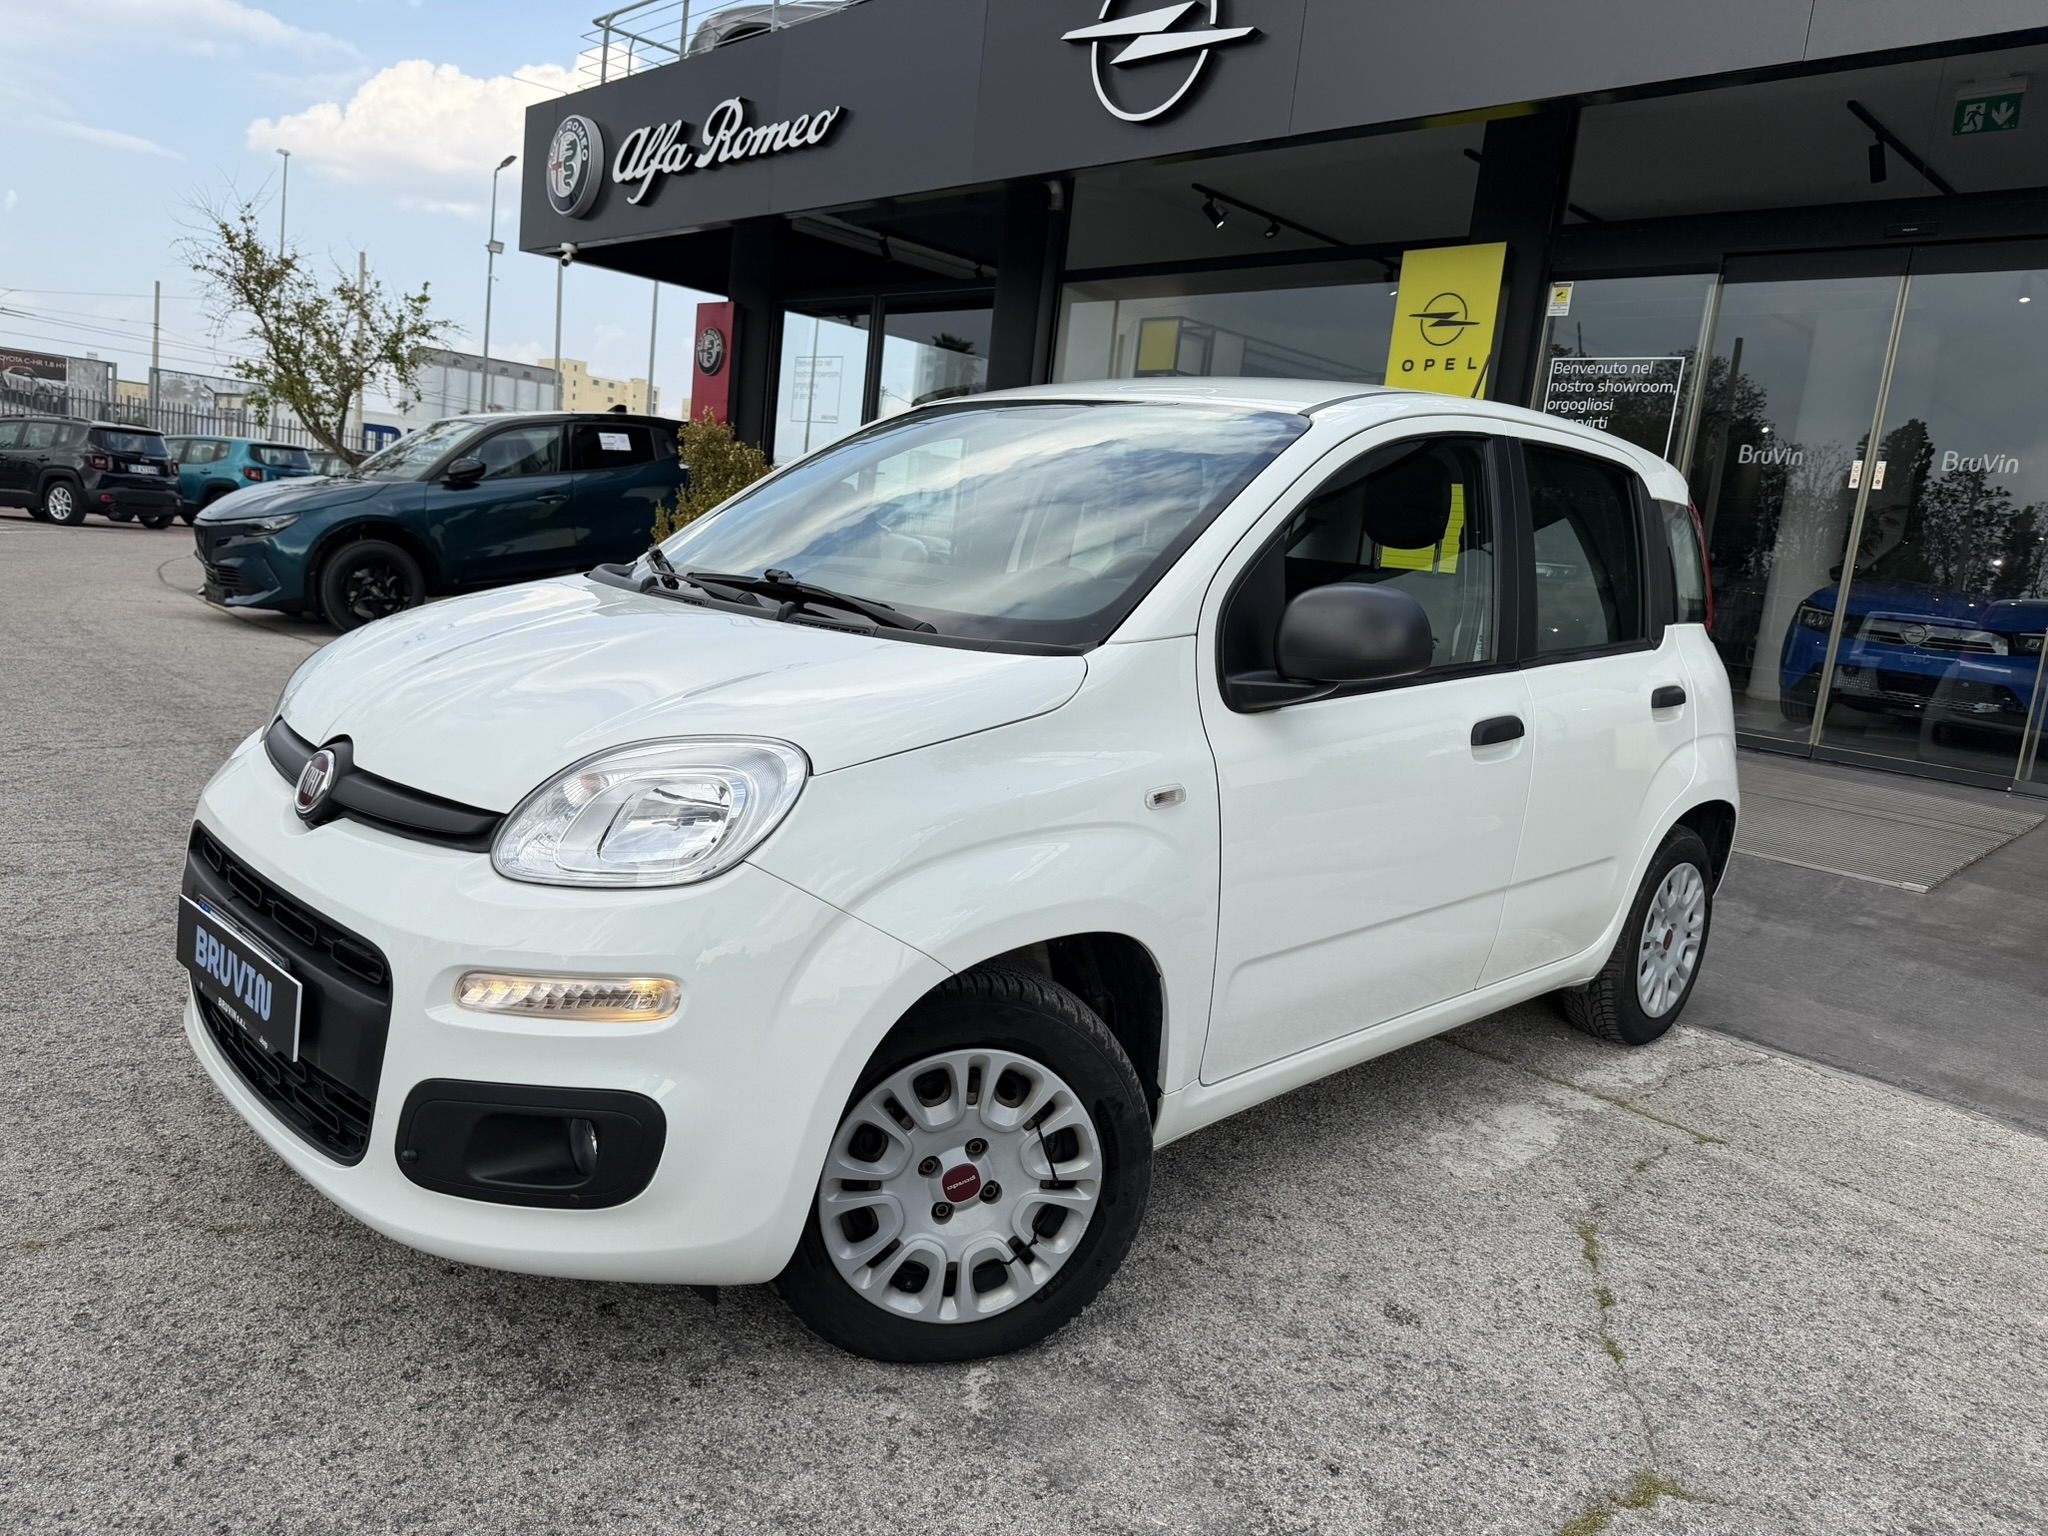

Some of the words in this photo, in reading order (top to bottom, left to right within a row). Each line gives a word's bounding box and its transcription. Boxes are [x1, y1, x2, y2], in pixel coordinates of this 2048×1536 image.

[612, 119, 692, 204] Alfa
[694, 96, 840, 168] Romeo
[0, 354, 22, 363] OYOTA
[1401, 357, 1477, 372] OPEL
[1553, 361, 1628, 374] Benvenuto
[1631, 361, 1653, 374] nel
[1550, 379, 1594, 393] nostro
[1597, 379, 1677, 395] showroom,
[1547, 398, 1614, 413] orgogliosi
[1737, 444, 1803, 465] BruVin
[1941, 450, 2019, 474] BruVin
[300, 765, 325, 797] FIAT
[195, 924, 273, 1021] BRUVIN
[946, 1174, 976, 1191] panda
